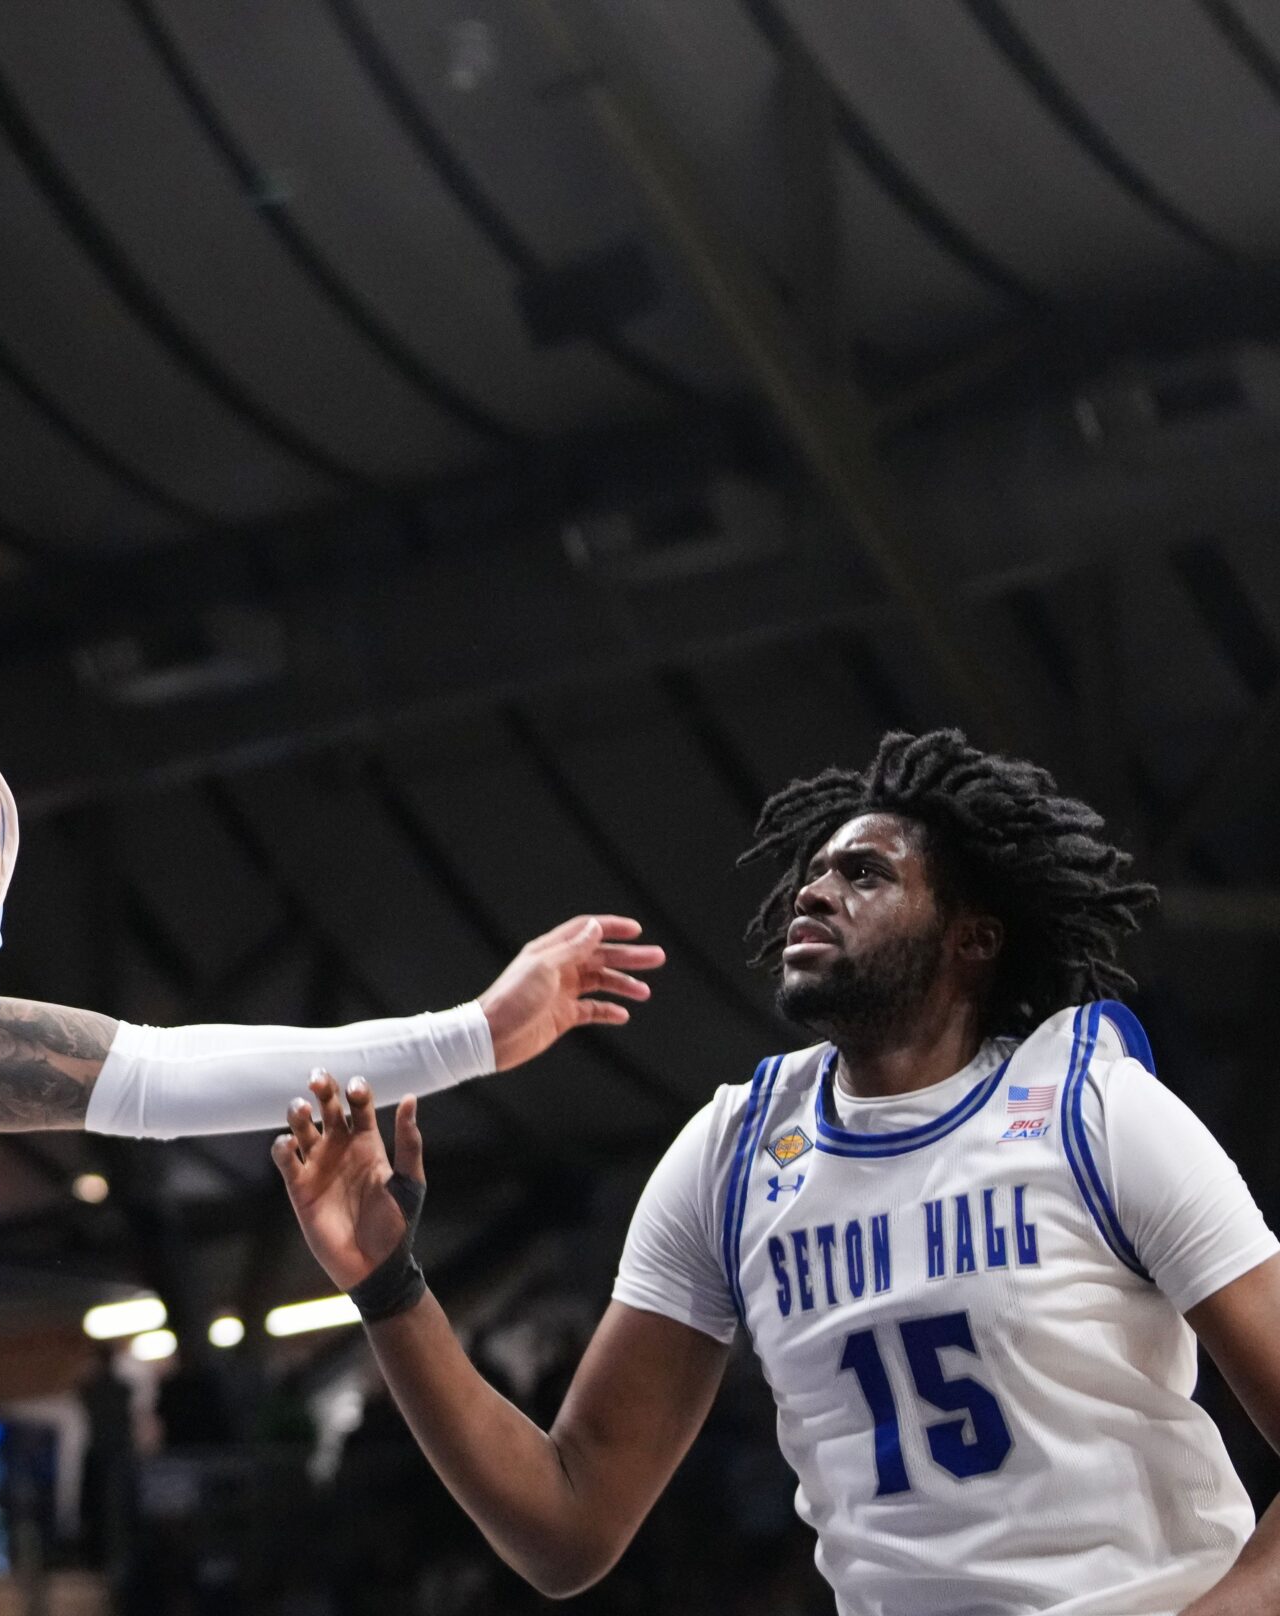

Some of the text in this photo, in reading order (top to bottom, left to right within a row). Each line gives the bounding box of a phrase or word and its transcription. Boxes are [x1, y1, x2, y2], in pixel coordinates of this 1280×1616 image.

[1001, 1124, 1051, 1139] EAST
[1010, 1117, 1045, 1130] BIG
[768, 1184, 1039, 1317] SETON HALL
[839, 1310, 1017, 1498] 15
